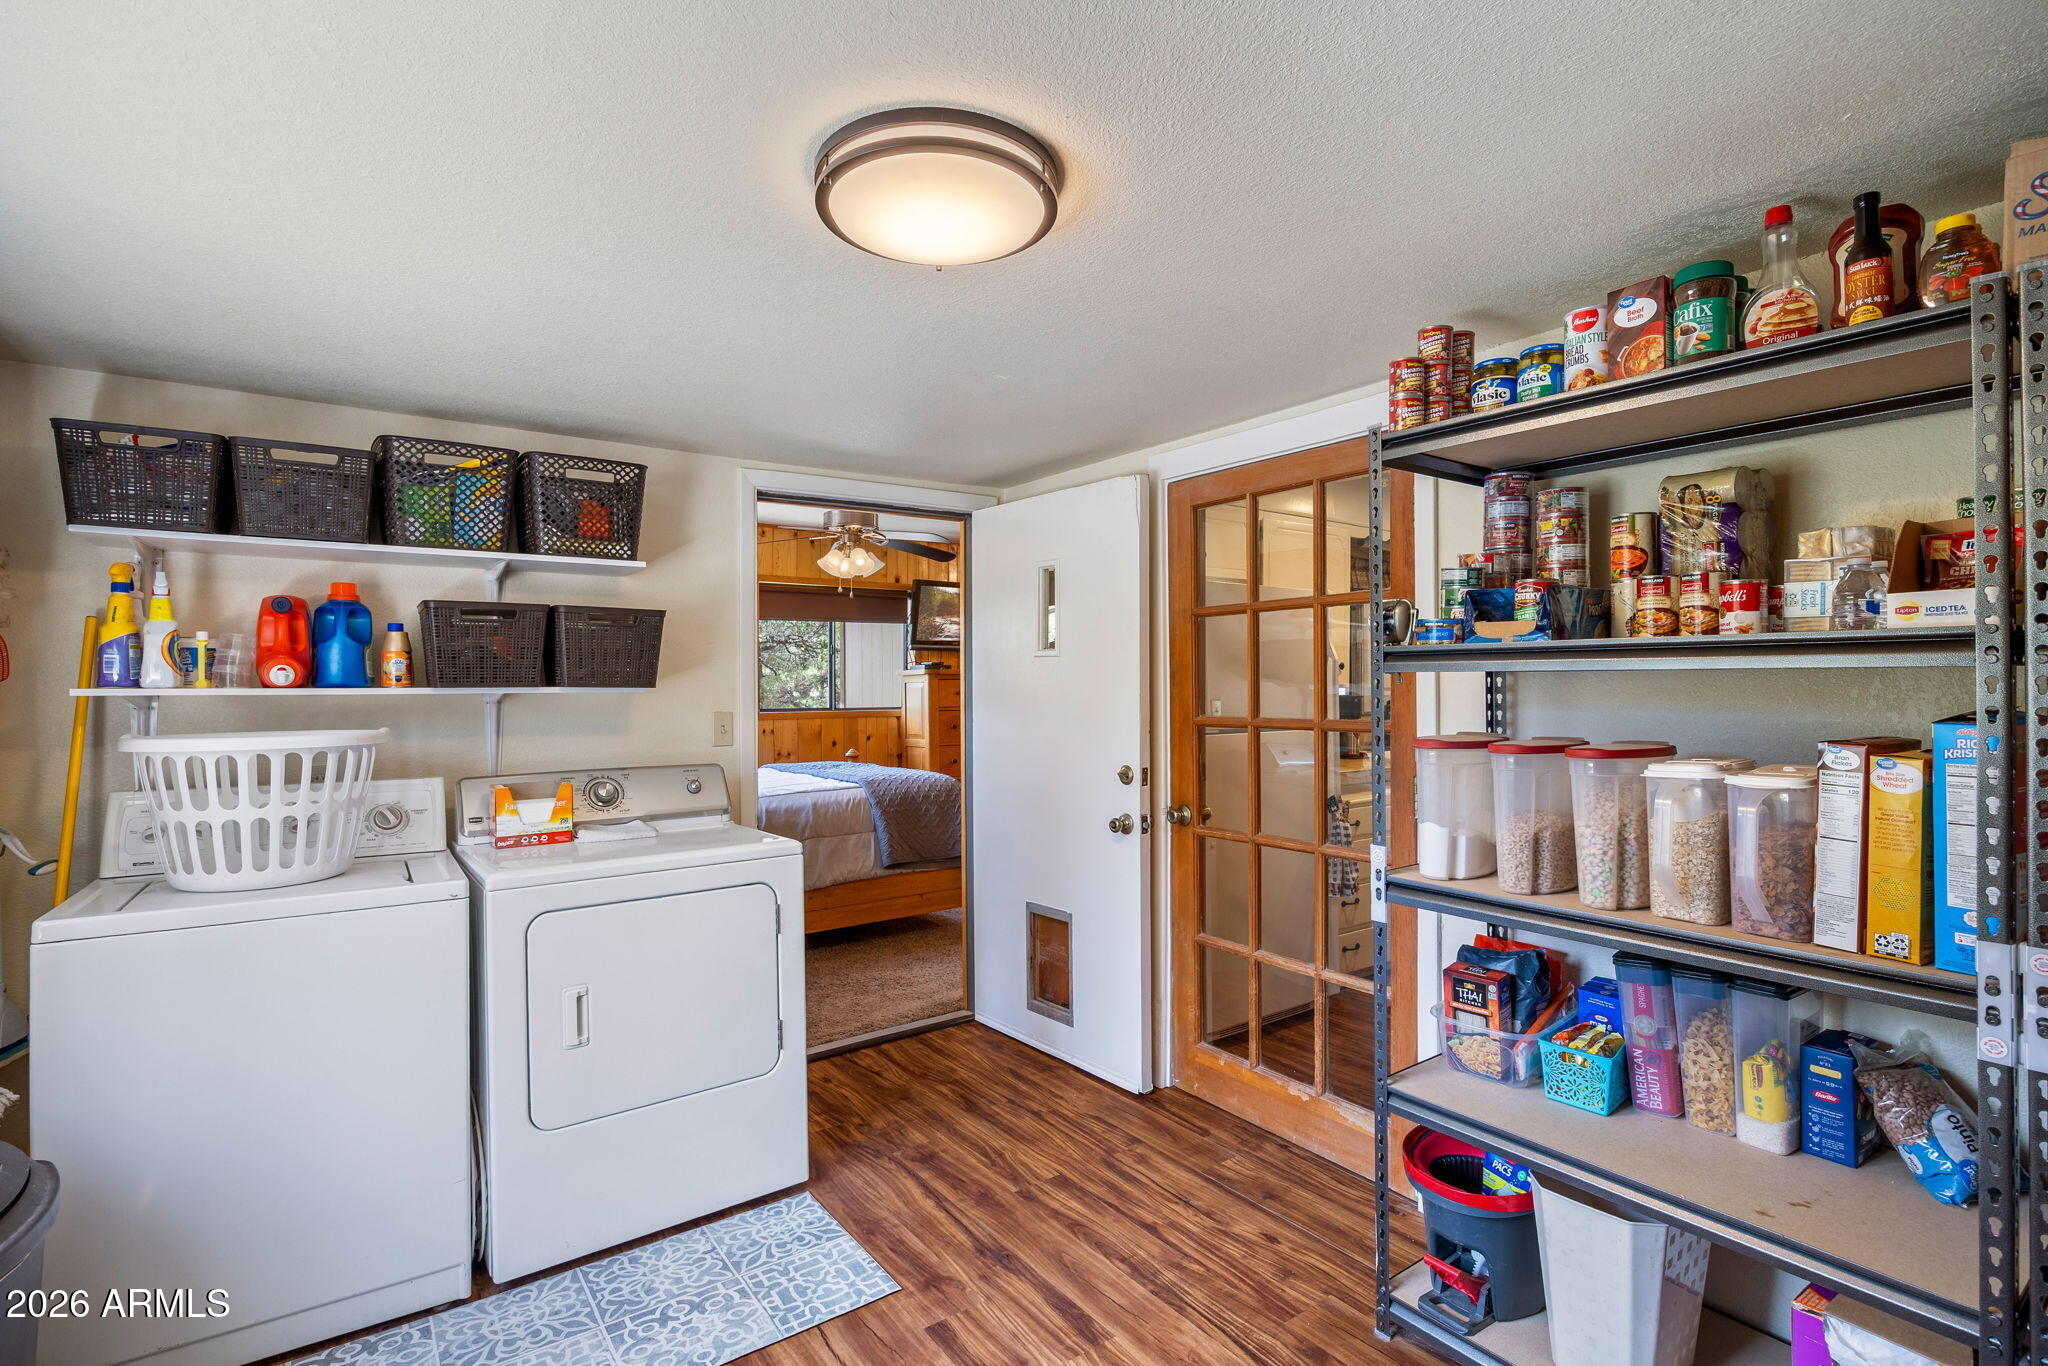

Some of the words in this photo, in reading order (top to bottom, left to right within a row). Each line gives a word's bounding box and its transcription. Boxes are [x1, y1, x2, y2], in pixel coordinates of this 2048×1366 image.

[1845, 274, 1886, 294] OYSTER
[1626, 305, 1644, 317] Beef
[1673, 301, 1713, 327] Cafix
[1626, 313, 1644, 323] Broth
[1762, 331, 1799, 346] Original
[1514, 591, 1542, 601] CHUNKY
[1800, 588, 1809, 611] Stacks
[1809, 589, 1819, 608] Fresh
[1896, 607, 1918, 615] Lipton
[1925, 605, 1948, 613] ICED
[1876, 774, 1914, 784] Shredded
[1882, 781, 1907, 789] Wheat
[1455, 987, 1484, 1003] THAI
[1459, 998, 1482, 1007] KITCHEN
[1632, 1048, 1650, 1109] AMERICAN
[1645, 1066, 1663, 1110] BEAUTY
[1814, 1091, 1837, 1102] Barilla
[1491, 1159, 1513, 1177] PACS
